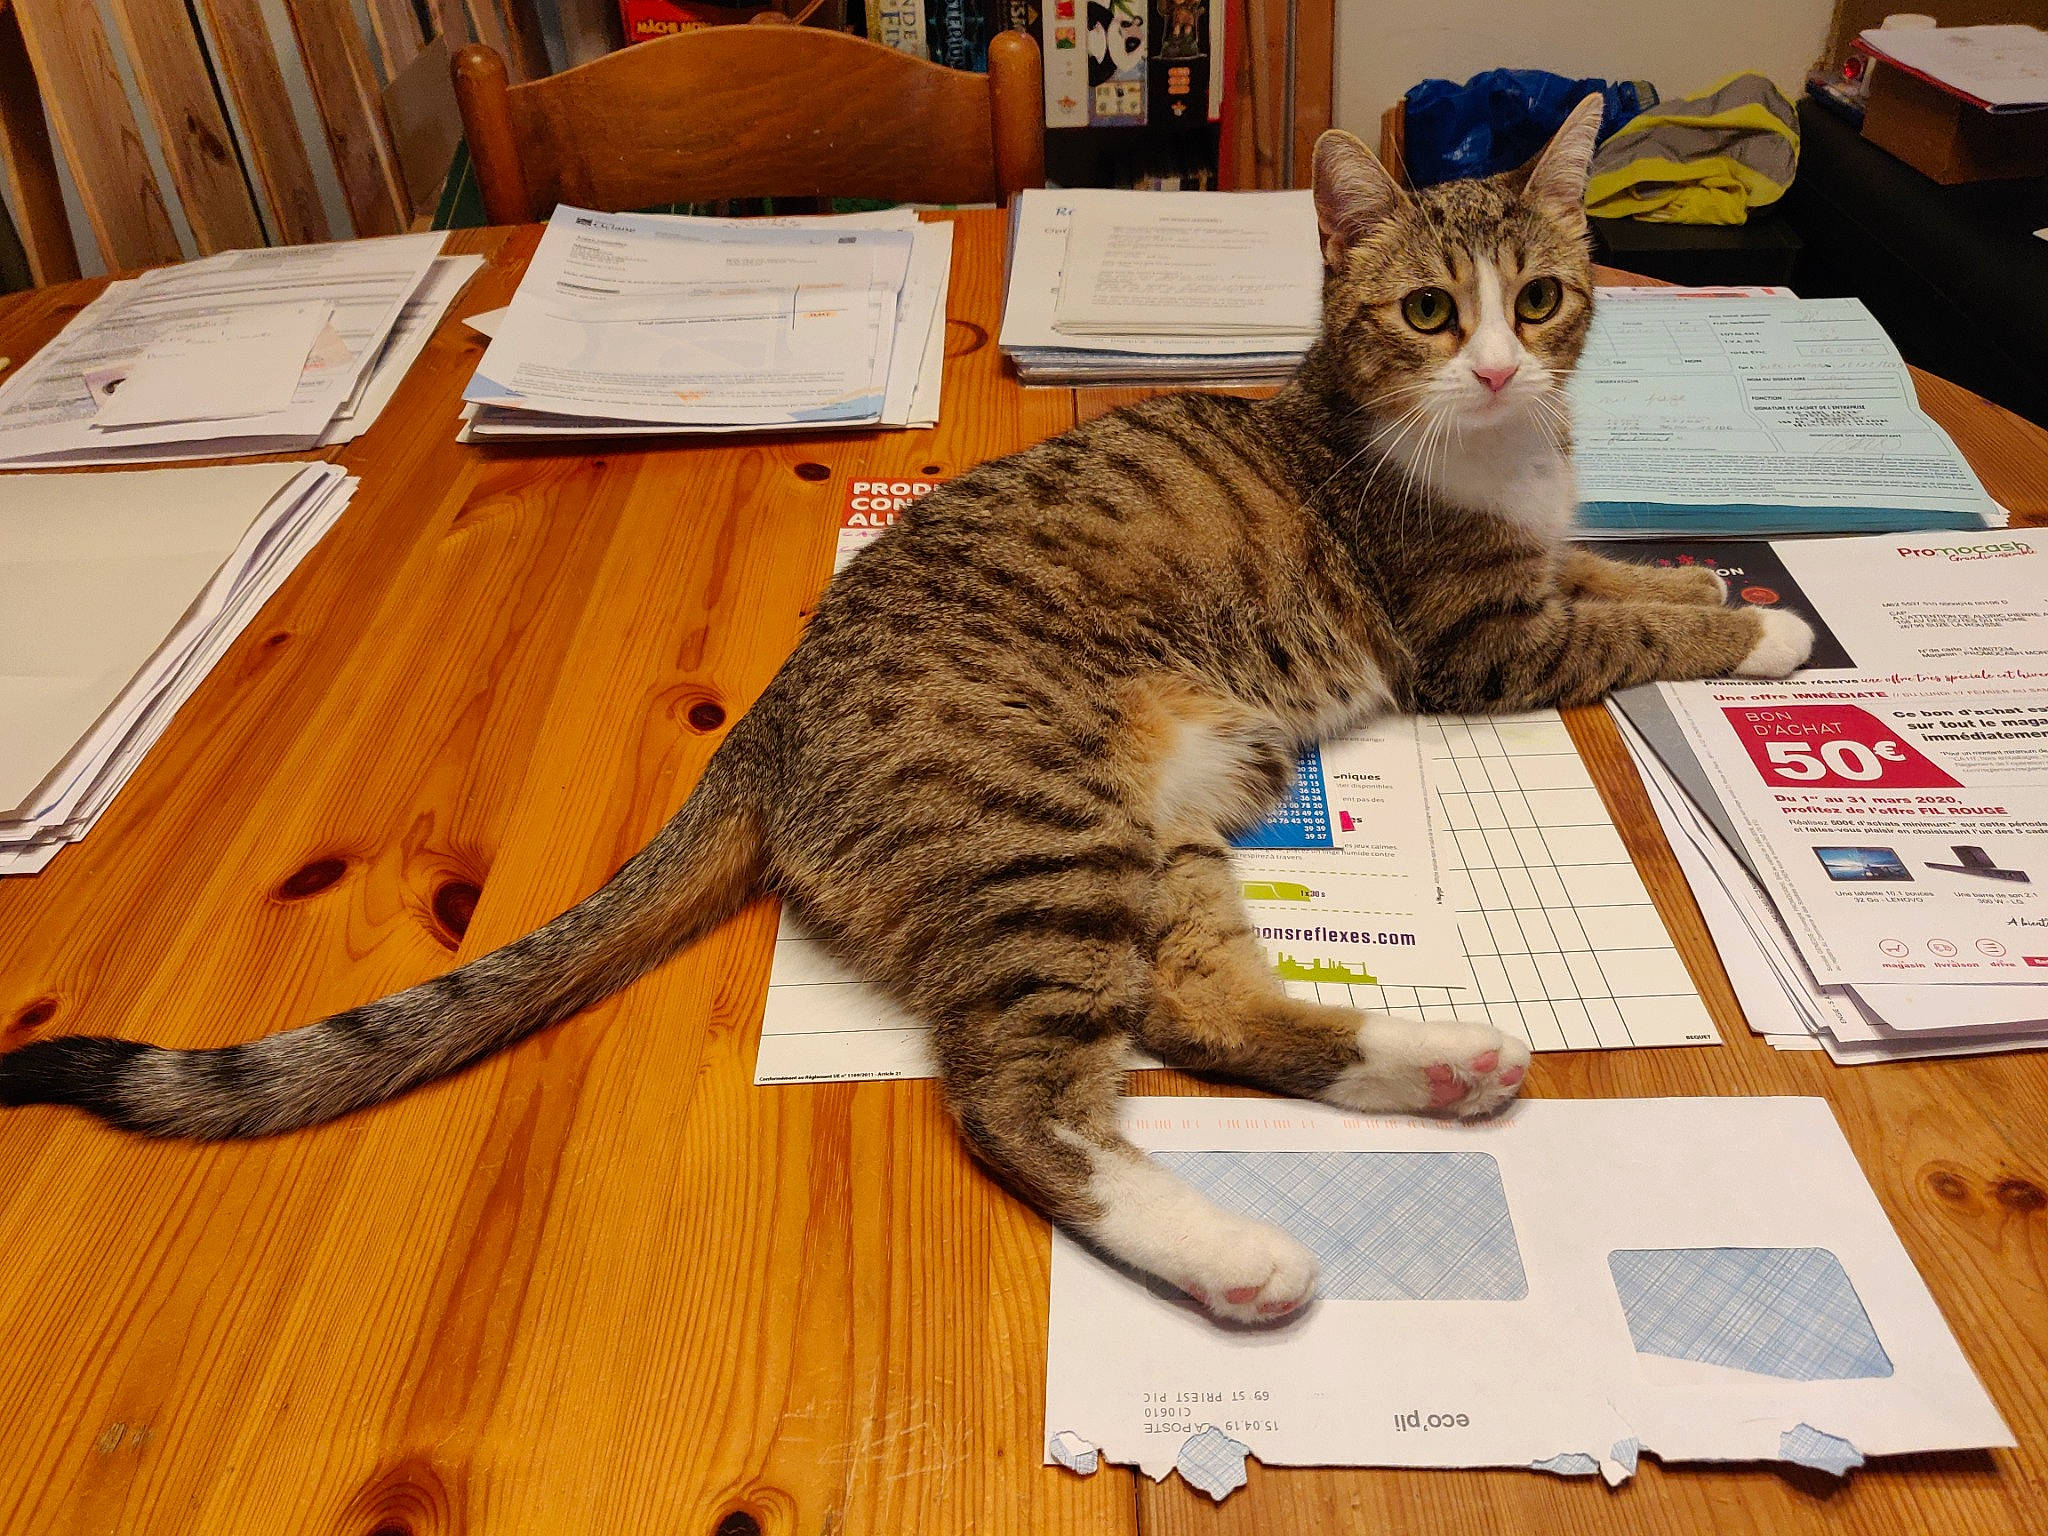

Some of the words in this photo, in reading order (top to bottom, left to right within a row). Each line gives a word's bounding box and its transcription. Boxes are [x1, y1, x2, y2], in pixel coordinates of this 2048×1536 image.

[1896, 541, 2032, 558] Promocash
[1884, 673, 1912, 684] offre
[1750, 692, 1788, 700] offre
[1792, 690, 1889, 700] IMMÉDIATE
[1746, 711, 1791, 722] BON
[1958, 707, 2024, 716] d'achat
[1754, 722, 1842, 736] D'ACHAT
[1938, 720, 1978, 729] tout
[1978, 719, 1997, 728] le
[1764, 740, 1907, 781] 50€
[1914, 796, 1963, 804] 2020,
[1143, 1392, 1167, 1402] PIC
[1175, 1392, 1222, 1402] PRIEST
[1231, 1391, 1245, 1401] ST
[1254, 1391, 1270, 1401] 69
[1225, 1420, 1279, 1431] 15.04.19
[1394, 1410, 1470, 1432] eco'pli
